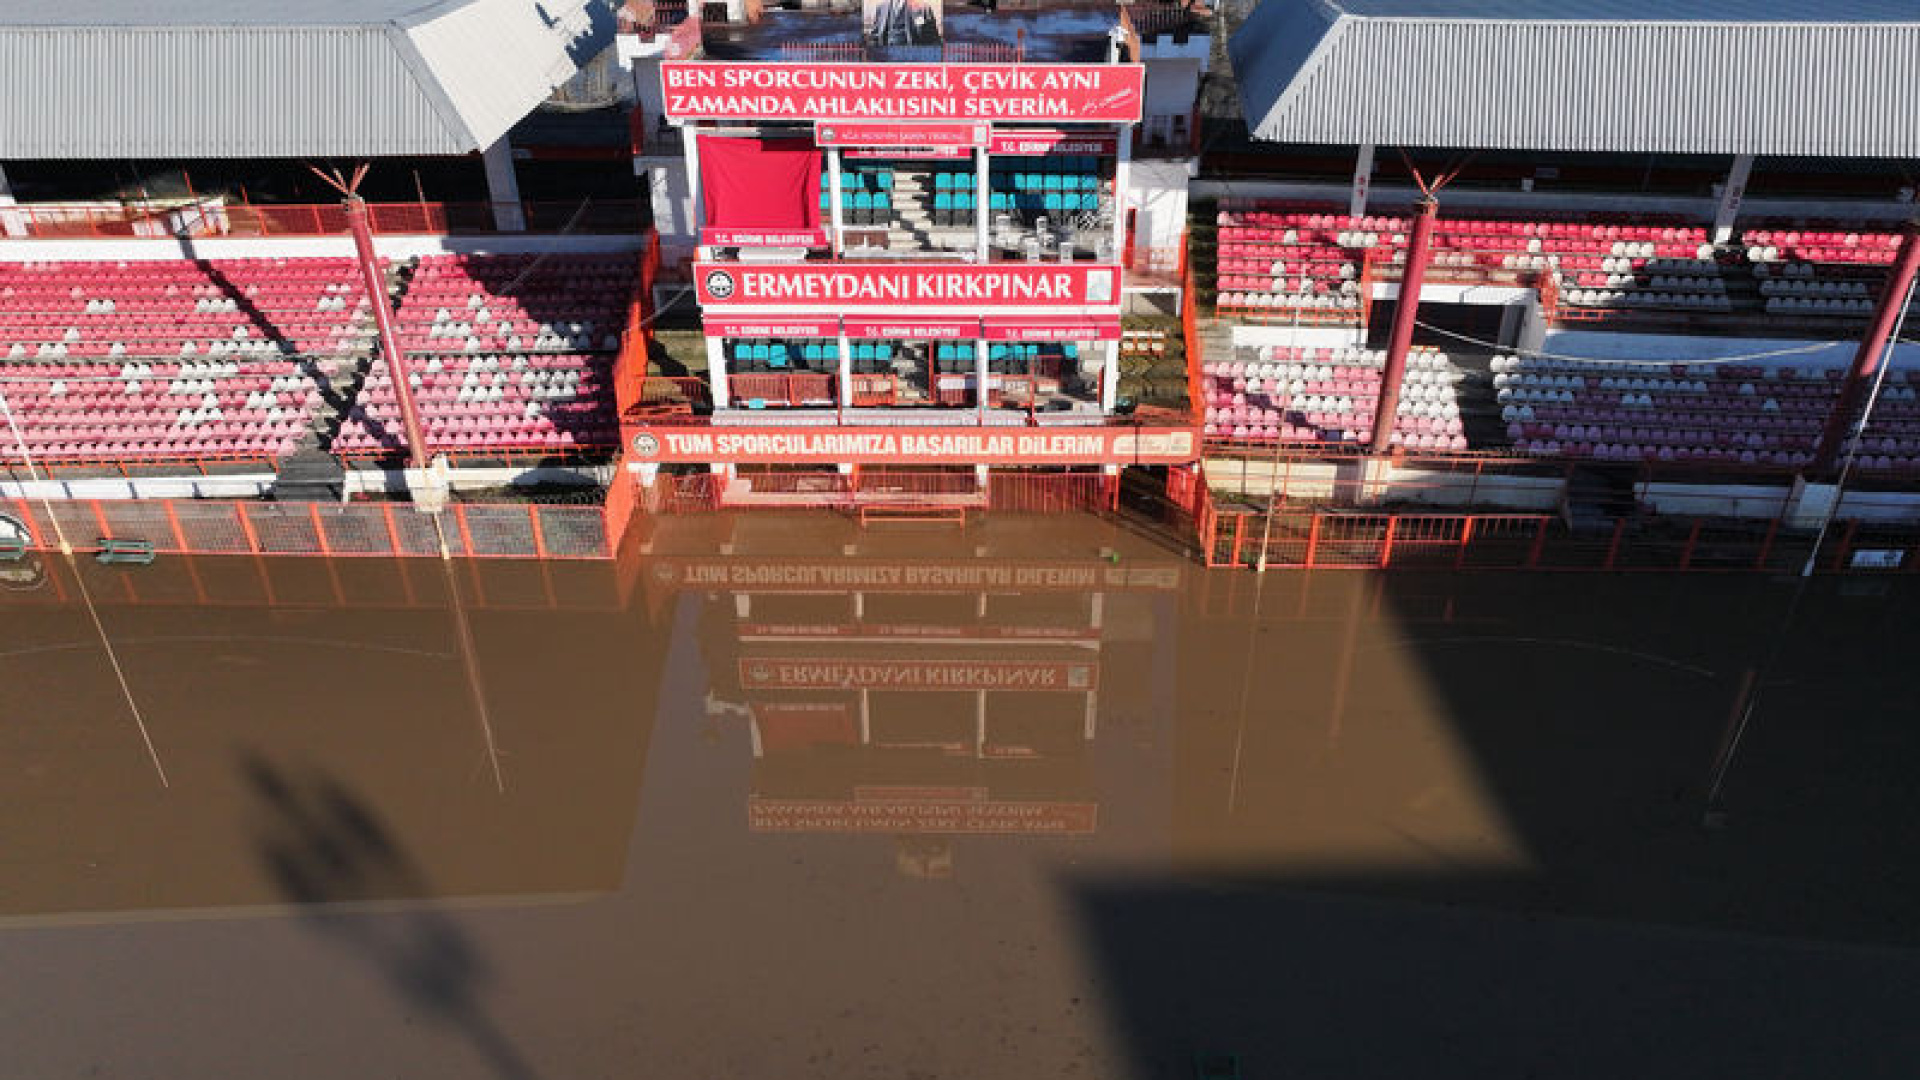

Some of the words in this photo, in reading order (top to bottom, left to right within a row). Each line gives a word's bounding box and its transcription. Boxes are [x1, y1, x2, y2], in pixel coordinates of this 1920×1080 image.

[668, 69, 716, 87] BEN
[724, 69, 886, 89] SPORCUNUN
[894, 67, 954, 93] ZEKİ,
[963, 67, 1036, 94] ÇEVİK
[1042, 71, 1101, 90] AYNI
[671, 96, 797, 114] ZAMANDA
[804, 97, 957, 115] AHLAKLISINI
[964, 94, 1076, 116] SEVERİM.
[742, 272, 911, 299] ERMEYDANI
[916, 273, 1073, 299] KIRKPINAR
[717, 434, 896, 455] SPORCULARIMIZA
[901, 434, 1014, 456] BAŞARILAR
